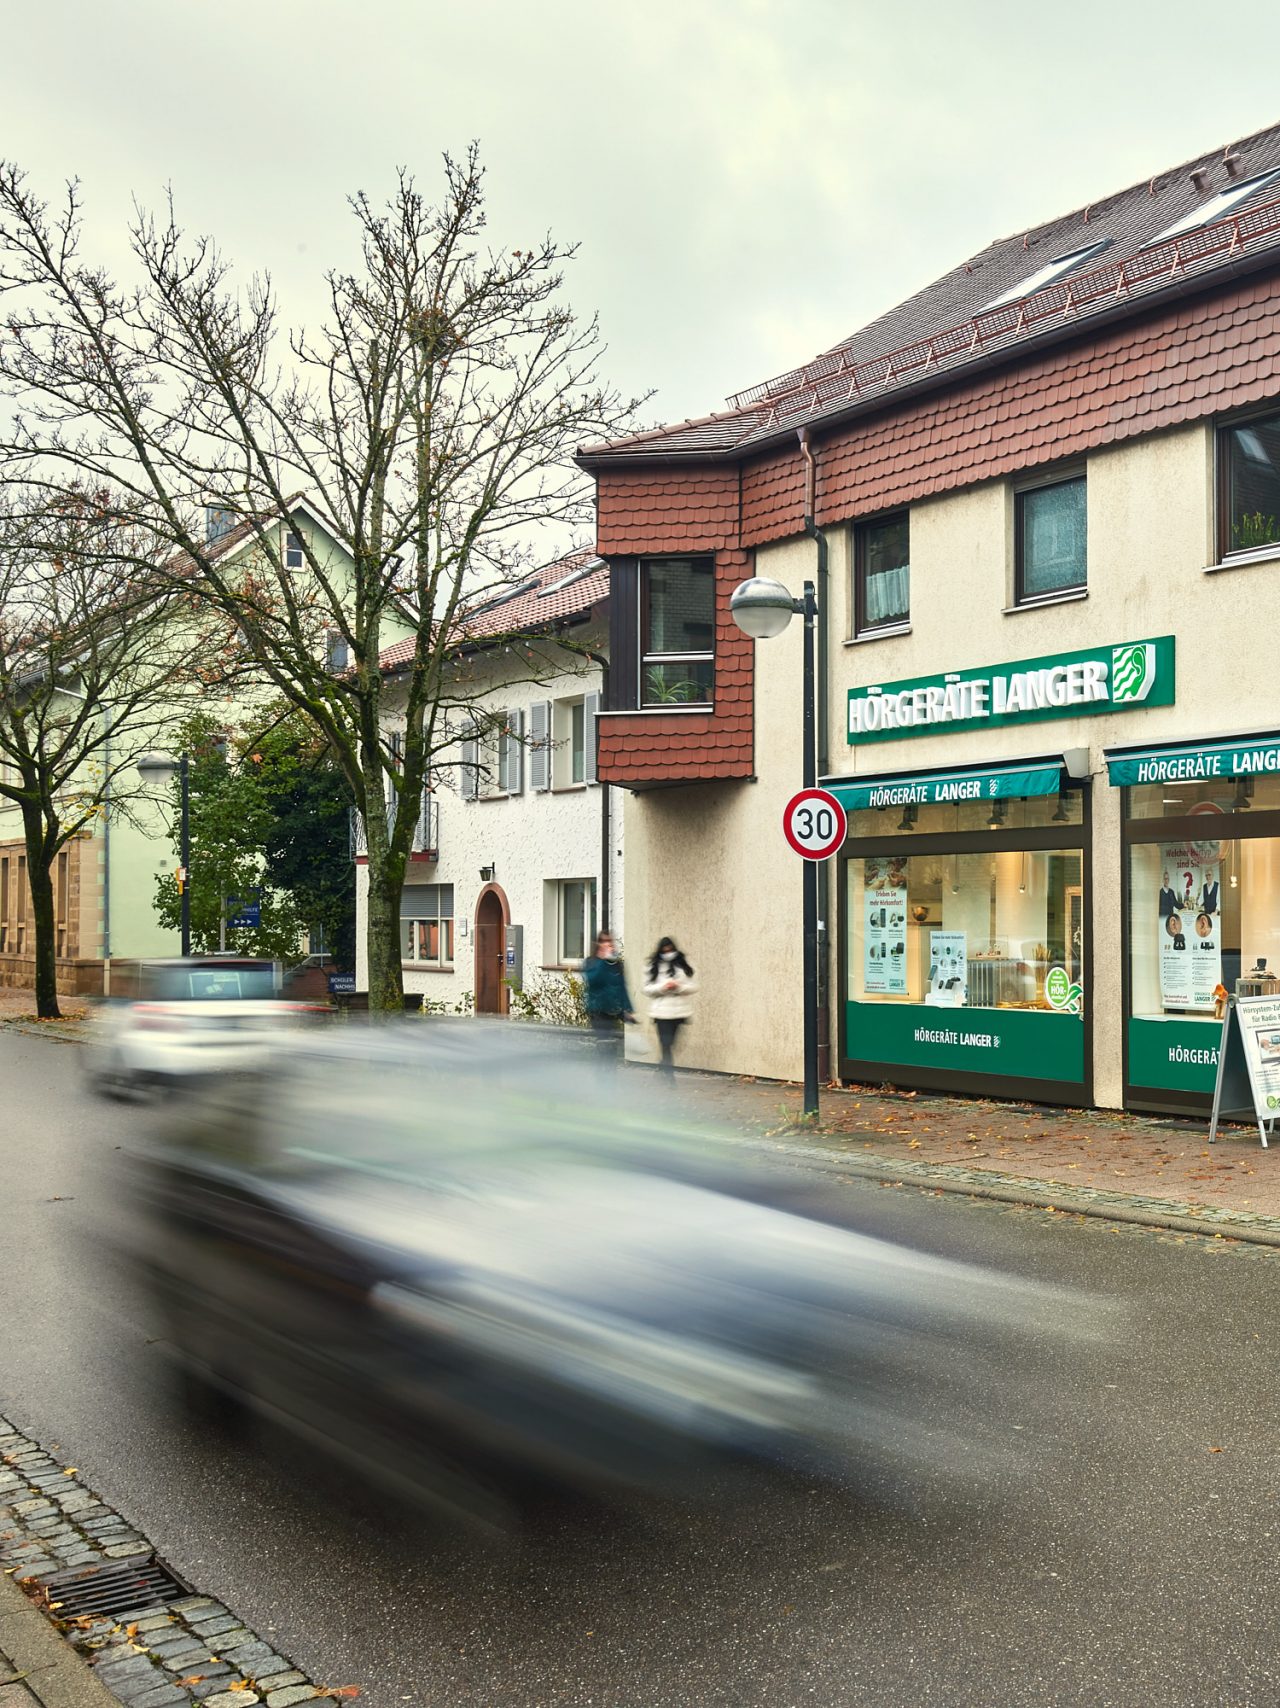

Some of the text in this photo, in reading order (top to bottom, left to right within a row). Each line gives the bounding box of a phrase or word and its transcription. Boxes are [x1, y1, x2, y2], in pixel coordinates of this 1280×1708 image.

[849, 661, 1110, 733] HÖRGERÄTE LANGER
[1138, 752, 1221, 782] HÖRGERÄTE
[869, 780, 981, 807] HÖRGERÄTE LANGER
[797, 808, 833, 840] 30
[914, 1026, 992, 1047] HÖRGERÄTE LANGER
[1168, 1044, 1221, 1065] HÖRGERÄ
